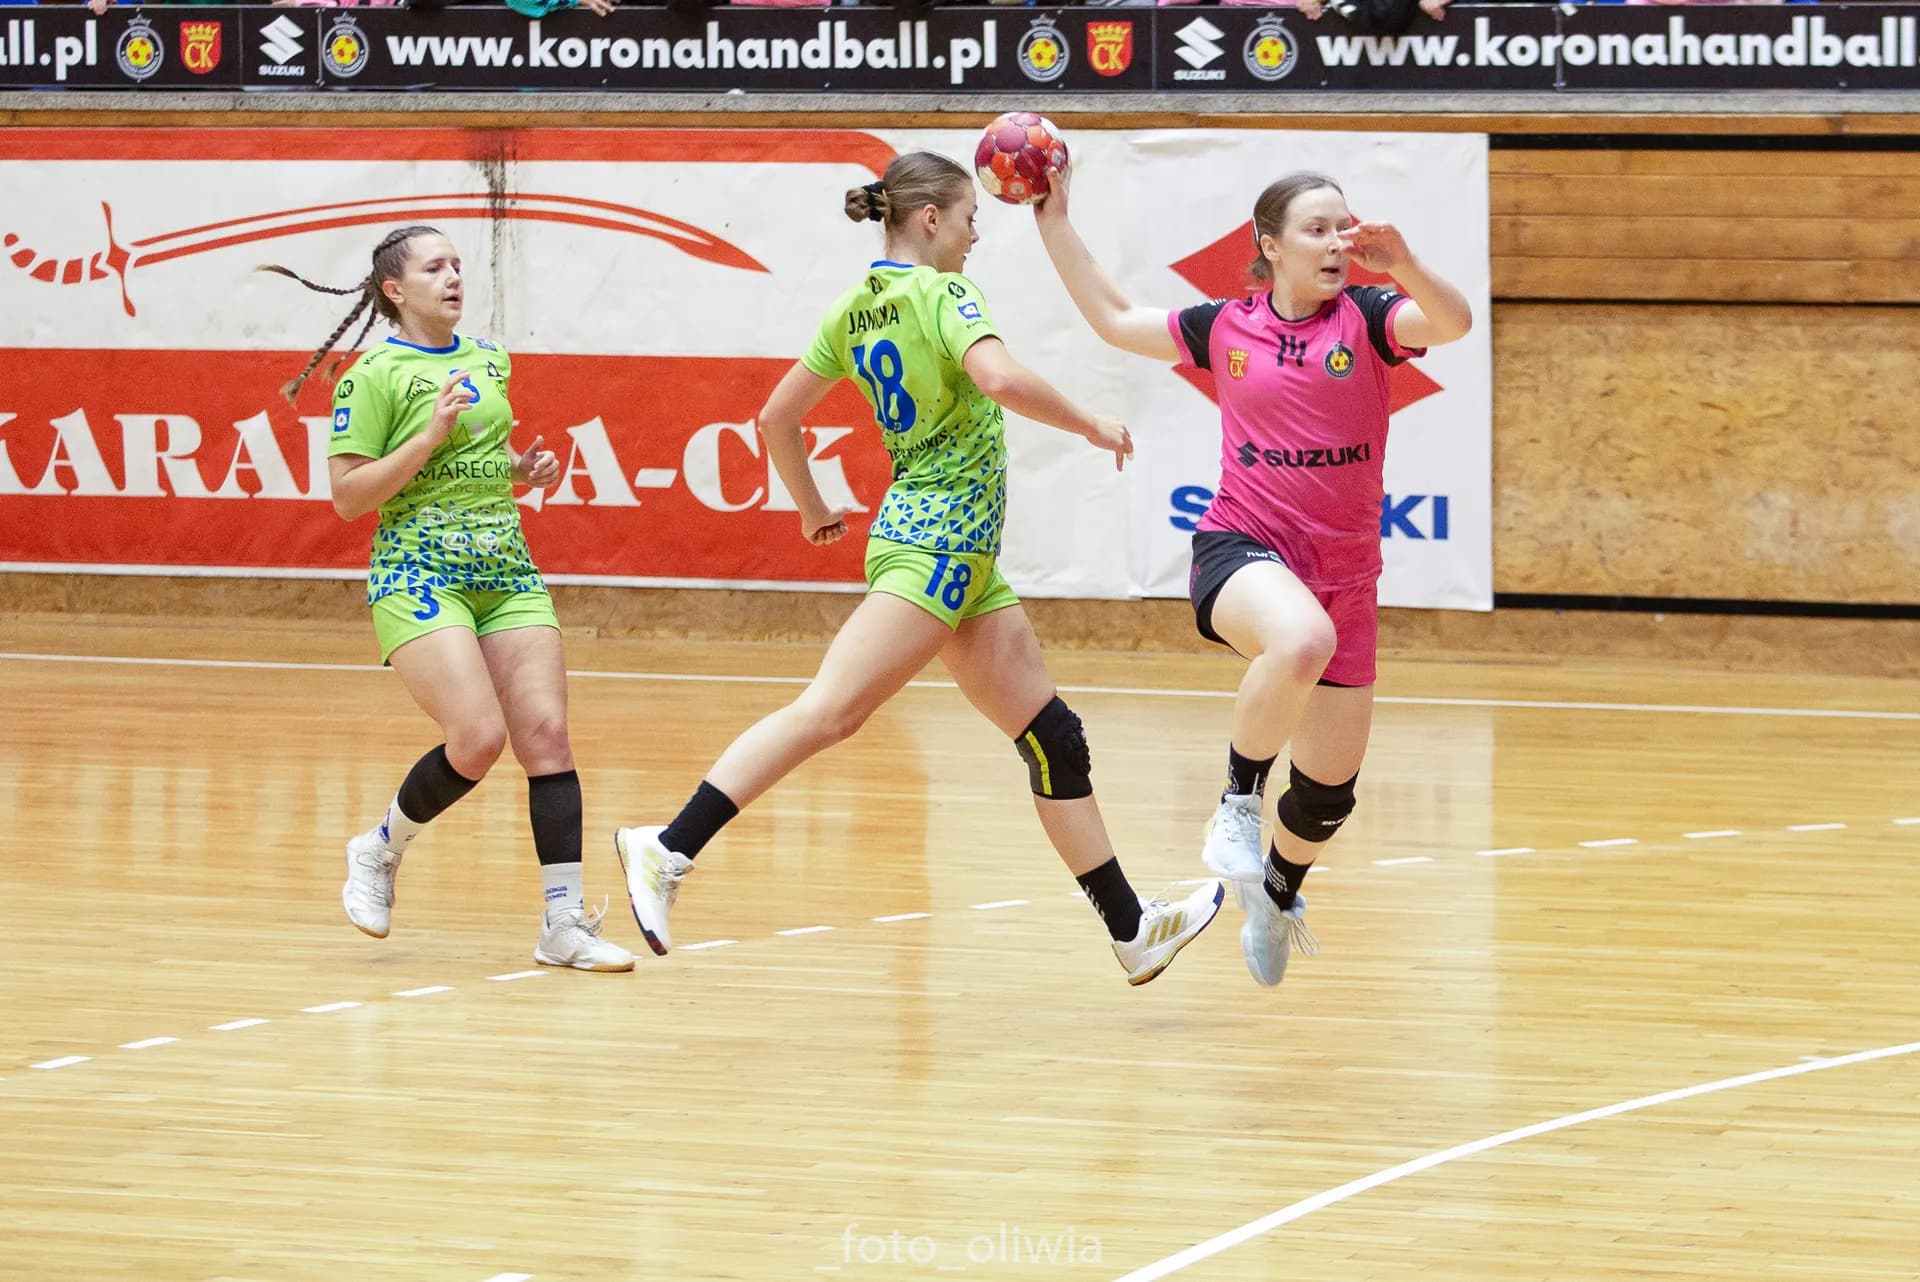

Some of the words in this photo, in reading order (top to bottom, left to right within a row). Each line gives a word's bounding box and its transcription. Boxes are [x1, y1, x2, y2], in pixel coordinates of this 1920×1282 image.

[184, 42, 214, 68] CK
[386, 20, 998, 84] www.koronahandball.pl
[1092, 39, 1126, 71] CK
[258, 65, 305, 77] SUZUKI
[1173, 69, 1226, 81] SUZUKI
[851, 339, 917, 434] 18
[1262, 442, 1371, 468] SUZUKI
[1169, 485, 1449, 541] SKI
[925, 554, 971, 611] 18
[411, 584, 441, 621] 3
